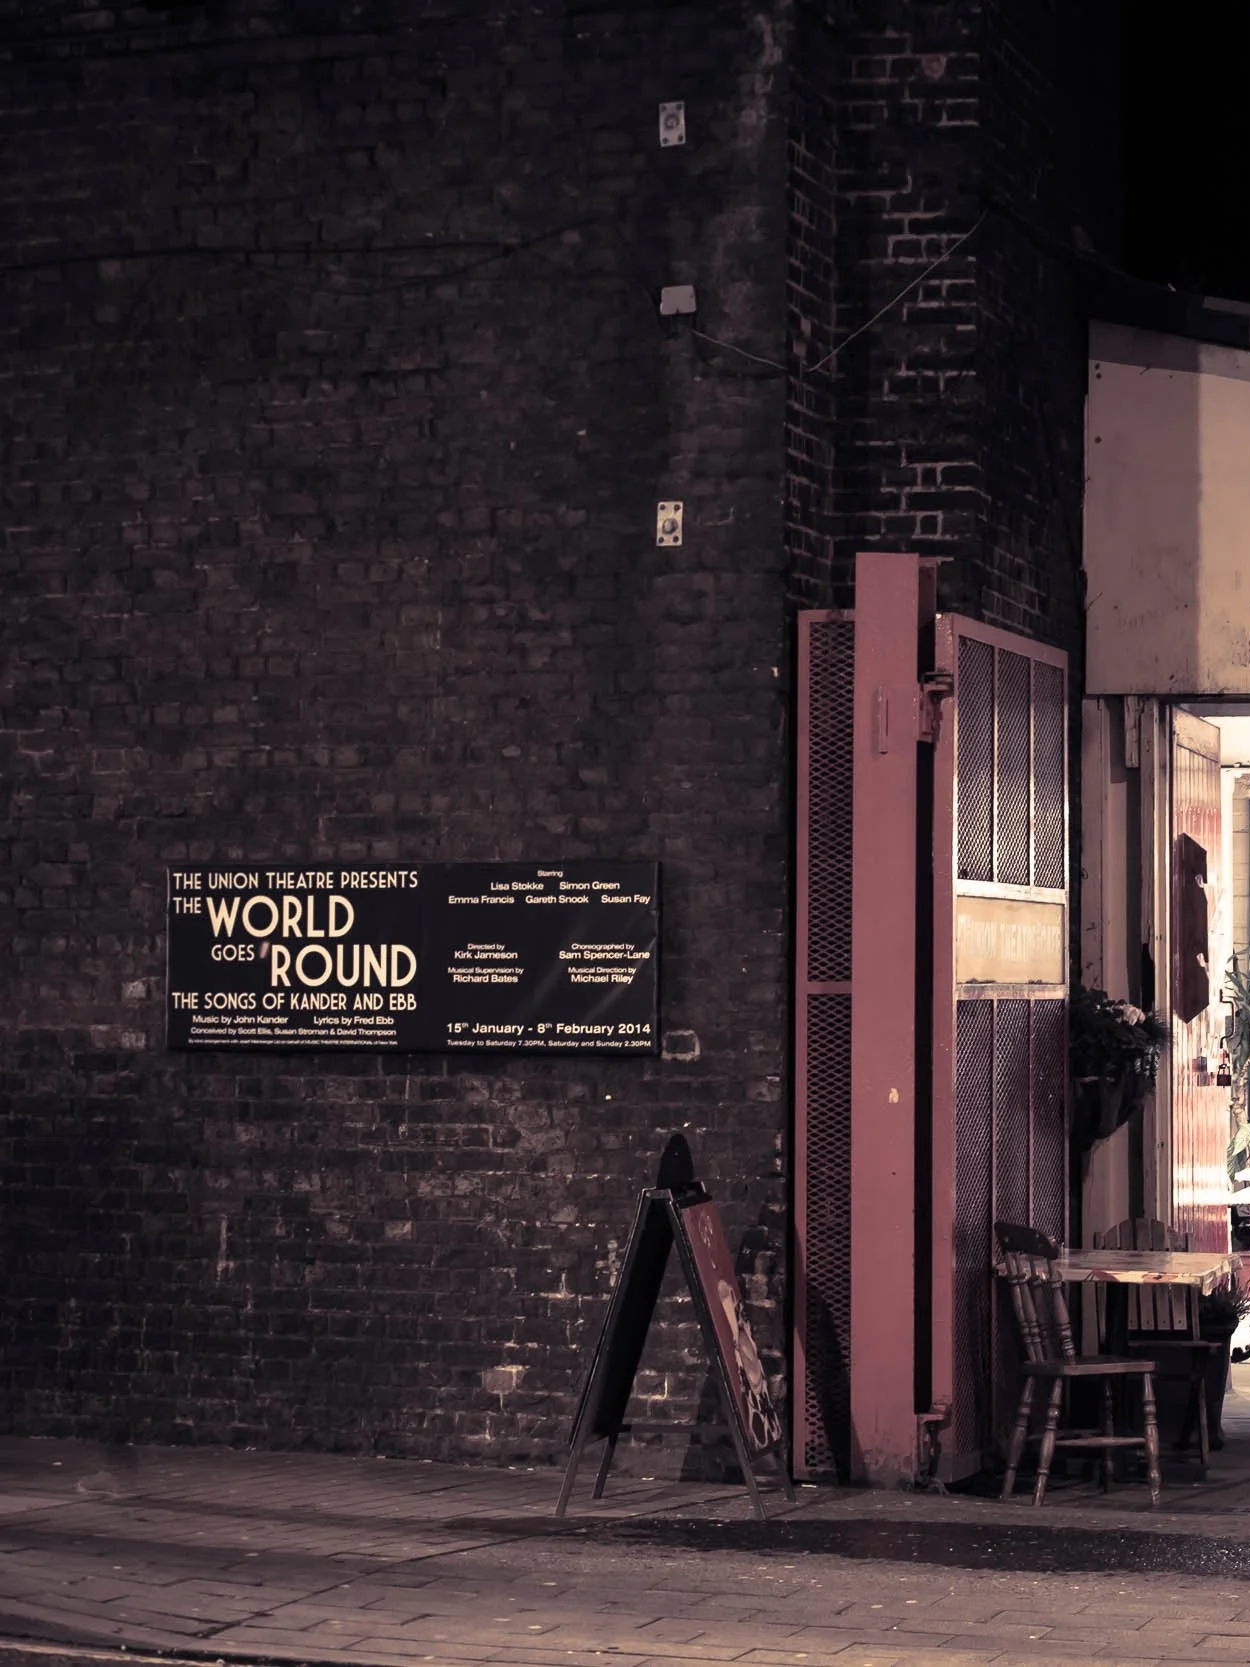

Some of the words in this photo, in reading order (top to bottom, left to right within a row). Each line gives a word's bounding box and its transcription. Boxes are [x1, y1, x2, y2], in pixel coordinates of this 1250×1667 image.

[173, 873, 202, 890] THE
[208, 873, 259, 889] UNION
[266, 872, 334, 889] THEATRE
[341, 871, 418, 888] PRESENTS
[491, 882, 509, 890] Lisa
[512, 882, 544, 890] Stokke
[560, 882, 590, 890] Simon
[449, 896, 479, 904] Emma
[525, 896, 556, 904] Gareth
[601, 895, 631, 903] Susan
[634, 895, 651, 905] Fay
[173, 897, 201, 914] THE
[206, 895, 355, 938] WORLD
[211, 944, 255, 961] GOES
[454, 951, 473, 959] Kirk
[475, 951, 518, 959] Jameson
[559, 951, 581, 959] Sam
[583, 951, 650, 960] Spencer-Lane
[628, 967, 636, 975] by
[453, 974, 488, 983] Richard
[491, 975, 518, 983] Bates
[571, 974, 609, 983] Michael
[611, 974, 633, 984] Riley
[172, 992, 198, 1009] THE
[204, 992, 256, 1009] SONGS
[262, 993, 284, 1009] OF
[290, 993, 346, 1010] KANDER
[353, 994, 383, 1009] AND
[390, 994, 417, 1010] EBB
[193, 1015, 219, 1024] Music
[221, 1015, 232, 1025] by
[234, 1016, 255, 1024] John
[257, 1016, 288, 1024] Kander
[314, 1016, 340, 1025] Lyrics
[341, 1016, 352, 1025] by
[354, 1016, 374, 1024] Fred
[376, 1016, 394, 1024] Ebb
[238, 1027, 256, 1035] Scott
[473, 1023, 524, 1036] January
[557, 1024, 614, 1036] February
[619, 1024, 651, 1034] 2014
